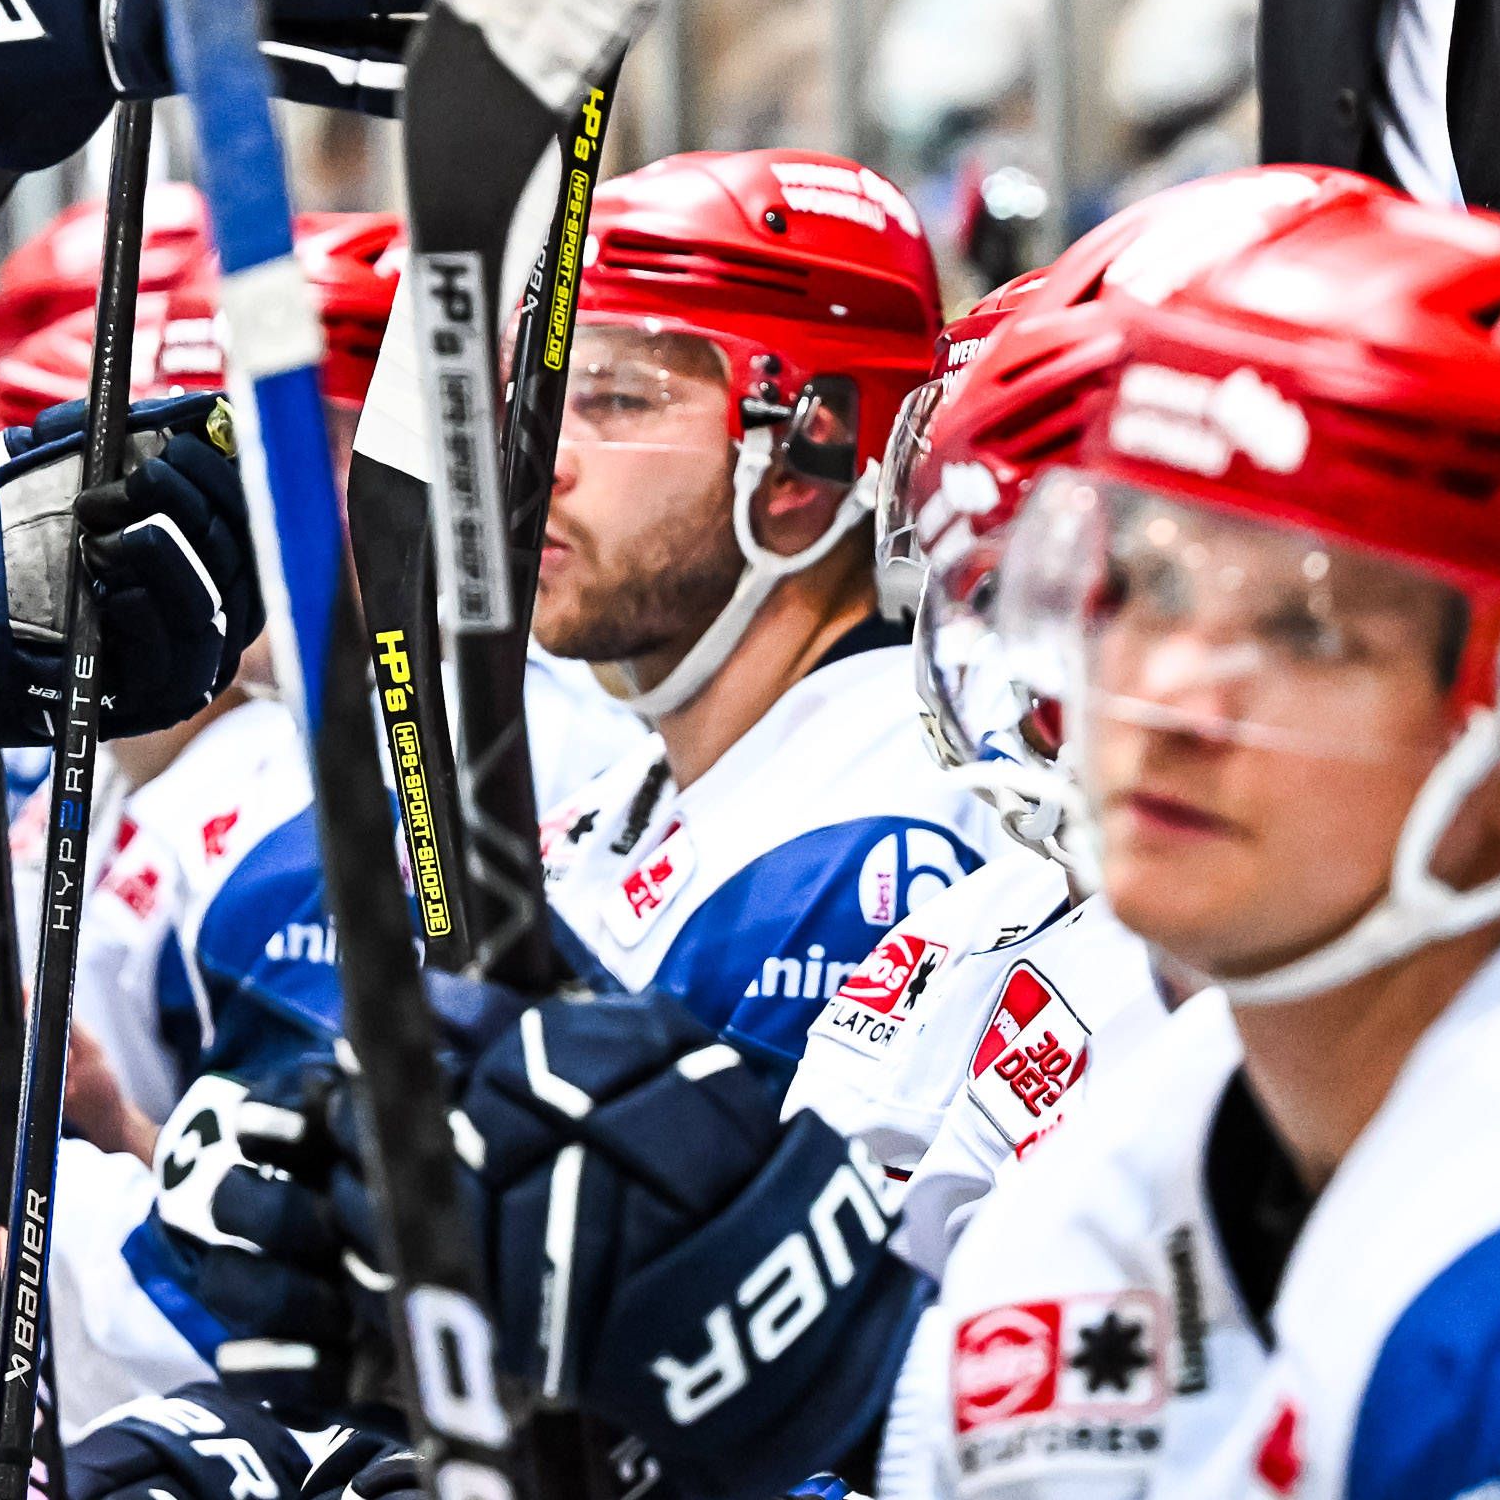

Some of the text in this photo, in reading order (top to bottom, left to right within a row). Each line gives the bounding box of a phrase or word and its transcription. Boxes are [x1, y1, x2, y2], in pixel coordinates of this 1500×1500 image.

[546, 172, 588, 367] HPS-SPORT-SHOP.DE
[374, 629, 409, 714] HP's
[51, 653, 96, 931] HYP2RLITE
[395, 725, 449, 935] HPS-SPORT-SHOP.DE
